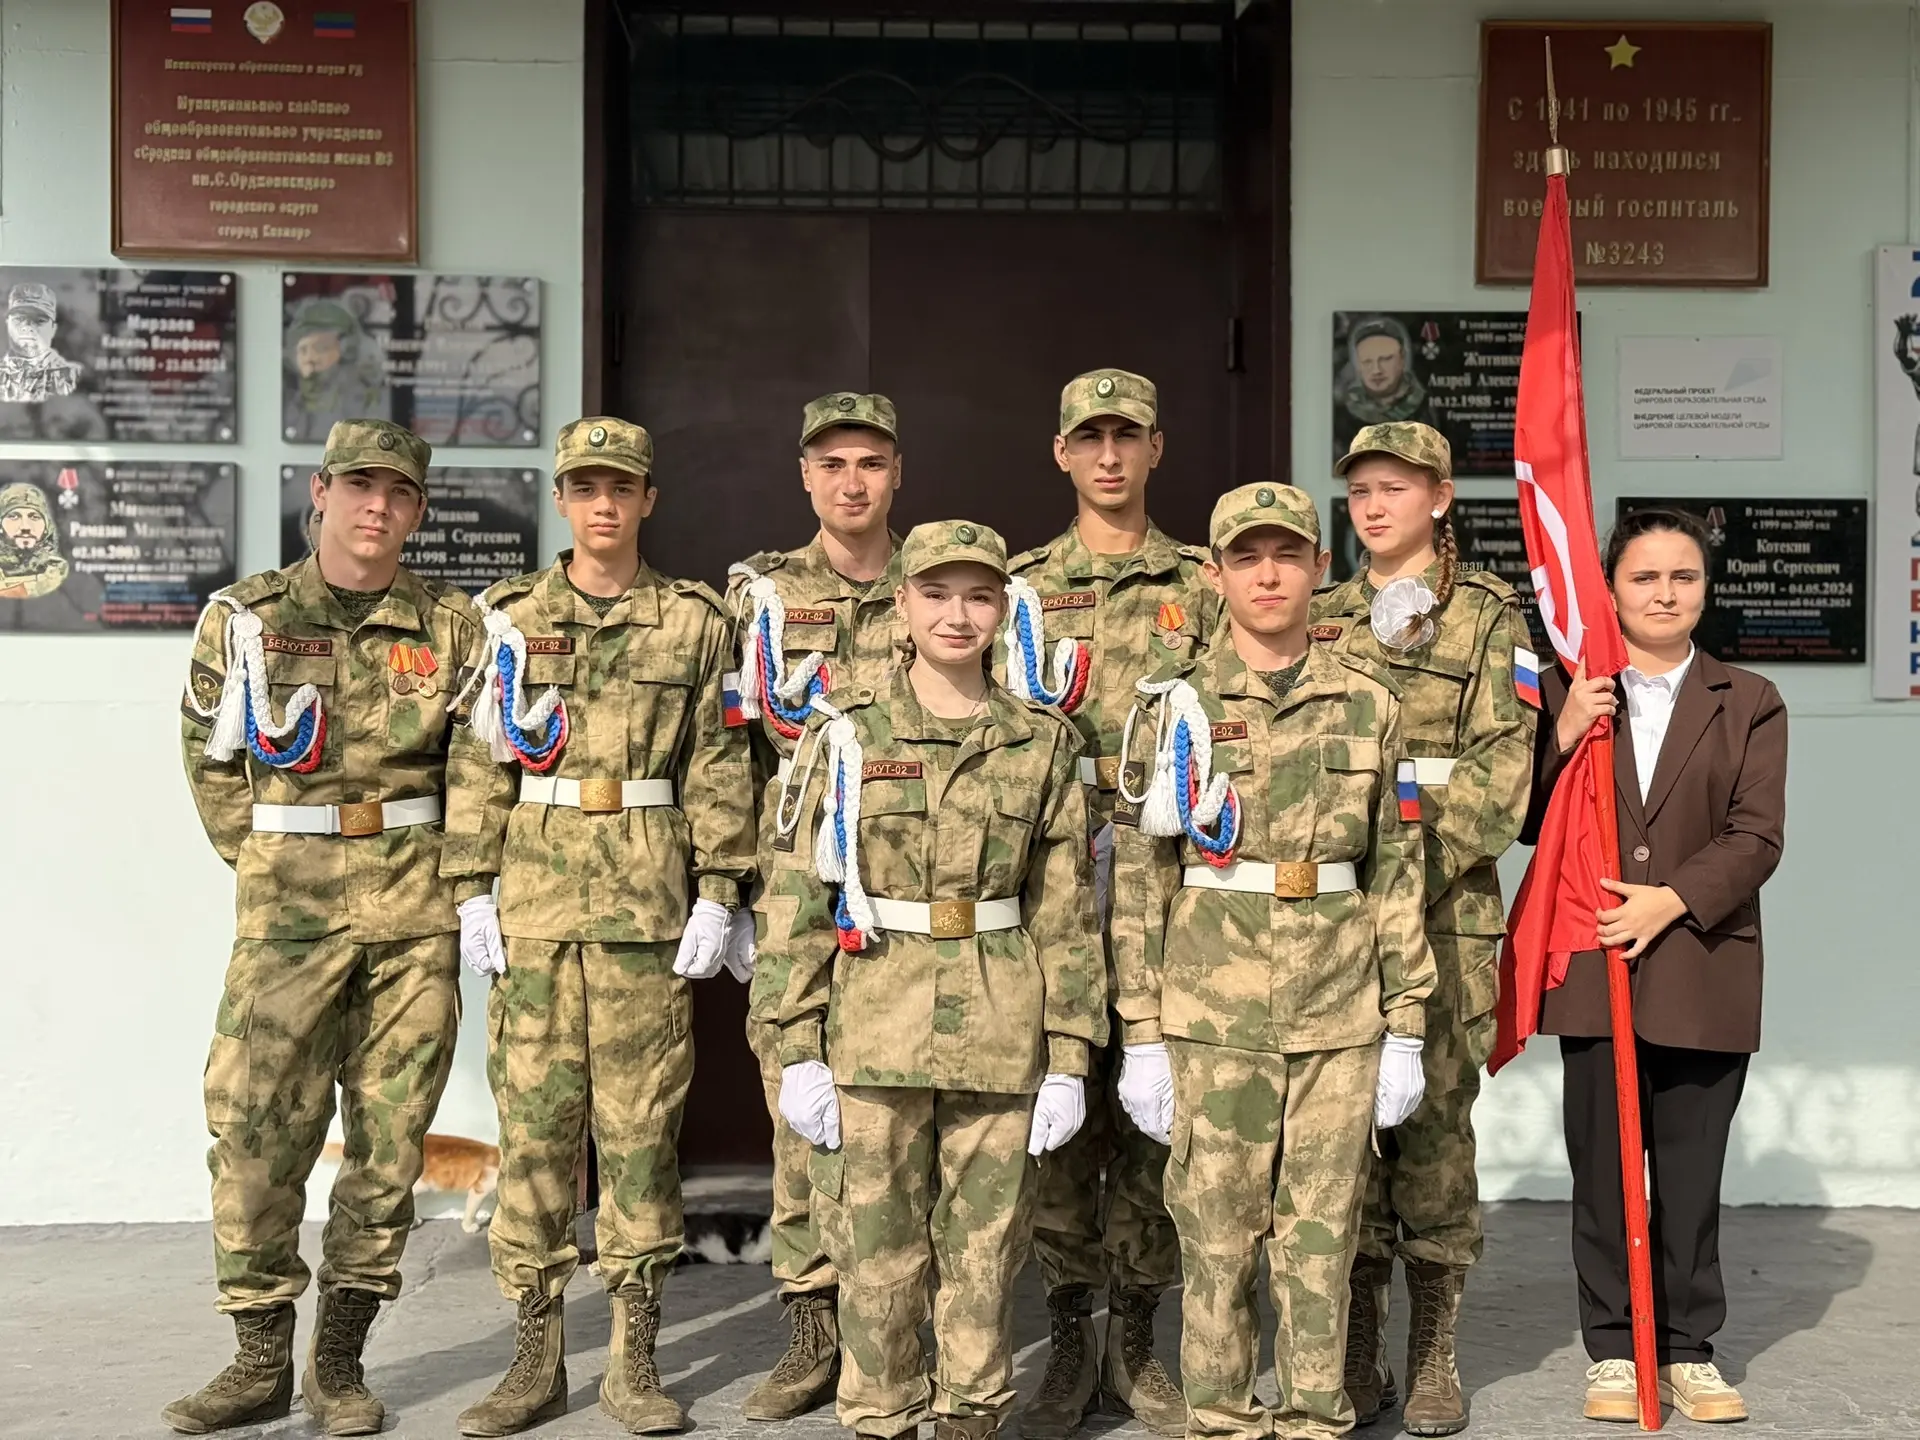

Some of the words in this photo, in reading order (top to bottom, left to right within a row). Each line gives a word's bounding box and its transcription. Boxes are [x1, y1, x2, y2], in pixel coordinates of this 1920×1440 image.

[1536, 97, 1590, 122] 141
[1603, 104, 1630, 122] по
[1643, 97, 1698, 122] 1945
[1513, 151, 1581, 173] здь
[1594, 149, 1720, 174] находился
[1503, 194, 1604, 218] воеый
[1617, 198, 1739, 219] госпиталь
[1586, 242, 1665, 266] №3243
[1634, 386, 1687, 396] ФЕДЕРАЛЬНЫЙ
[1688, 387, 1716, 395] ПРОЕКТ
[1634, 396, 1673, 405] ЦИФРОВАЯ
[1673, 396, 1742, 404] ОБРАЗОВАТЕЛЬНАЯ
[1743, 396, 1768, 405] СРЕДА
[1633, 412, 1675, 421] ВНЕДРЕНИЕ
[1676, 411, 1710, 421] ЦЕЛЕВОЙ
[1710, 412, 1742, 420] МОДЕЛИ
[1633, 421, 1673, 430] ЦИФРОВОЙ
[1674, 421, 1744, 429] ОБРАЗОВАТЕЛЬНОЙ
[1744, 422, 1770, 430] СРЕДЫ
[405, 530, 446, 546] итрий
[451, 527, 521, 547] Сергеевич
[1756, 538, 1811, 554] Котекин
[398, 552, 448, 565] 07.1998
[1455, 561, 1484, 571] зван
[1726, 557, 1767, 578] Юрий
[1772, 558, 1840, 578] Сергеевич
[1042, 596, 1084, 607] ЕРКУТ-02
[784, 611, 824, 620] ЕРКУТ-02
[267, 637, 320, 653] БЕРКУТ-02
[526, 640, 560, 650] КУТ-02
[862, 764, 908, 777] ЕРКУТ-02
